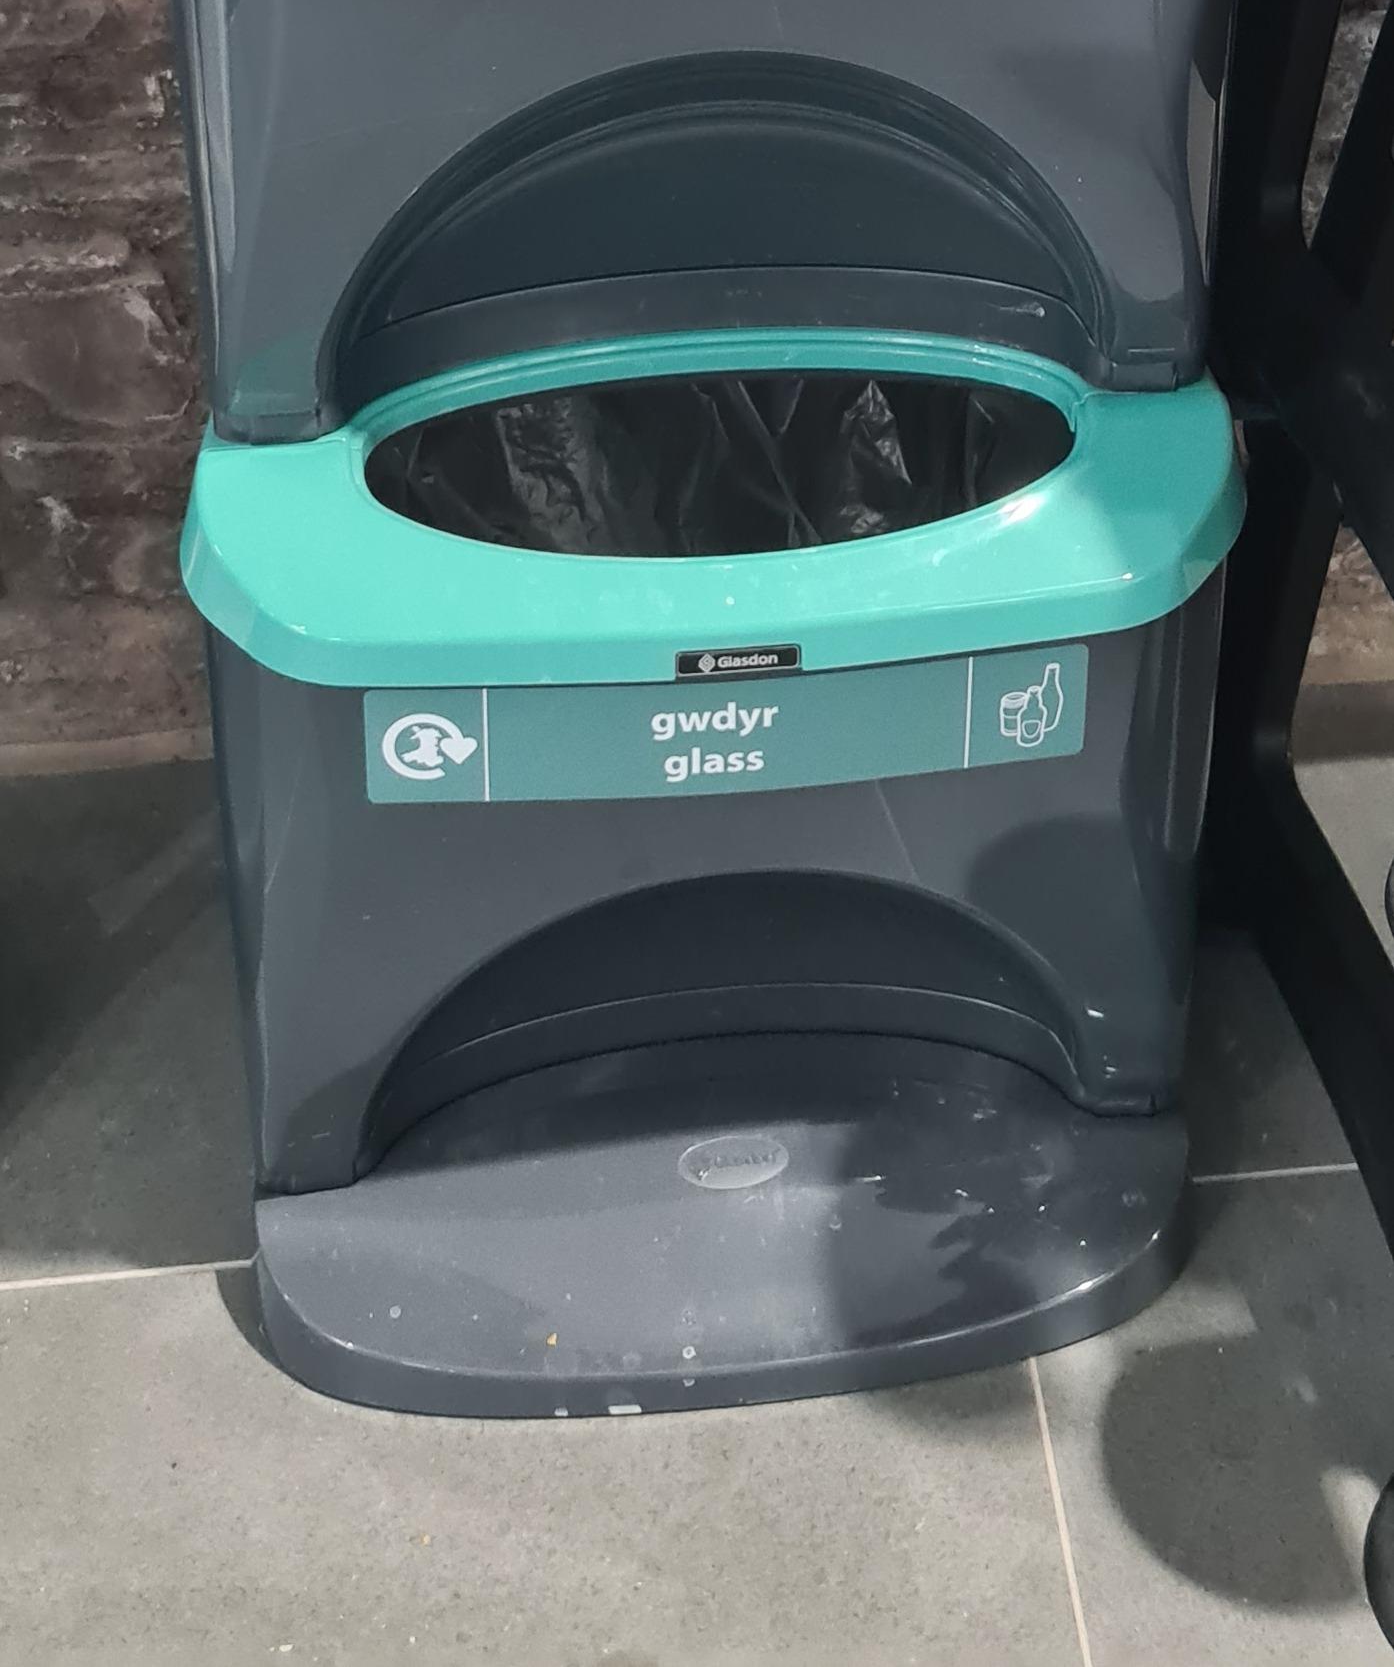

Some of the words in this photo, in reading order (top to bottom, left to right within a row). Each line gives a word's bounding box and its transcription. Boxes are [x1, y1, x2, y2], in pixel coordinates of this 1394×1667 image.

[717, 653, 779, 668] Glasdon
[651, 701, 779, 741] gwdyr
[664, 747, 764, 783] glass
